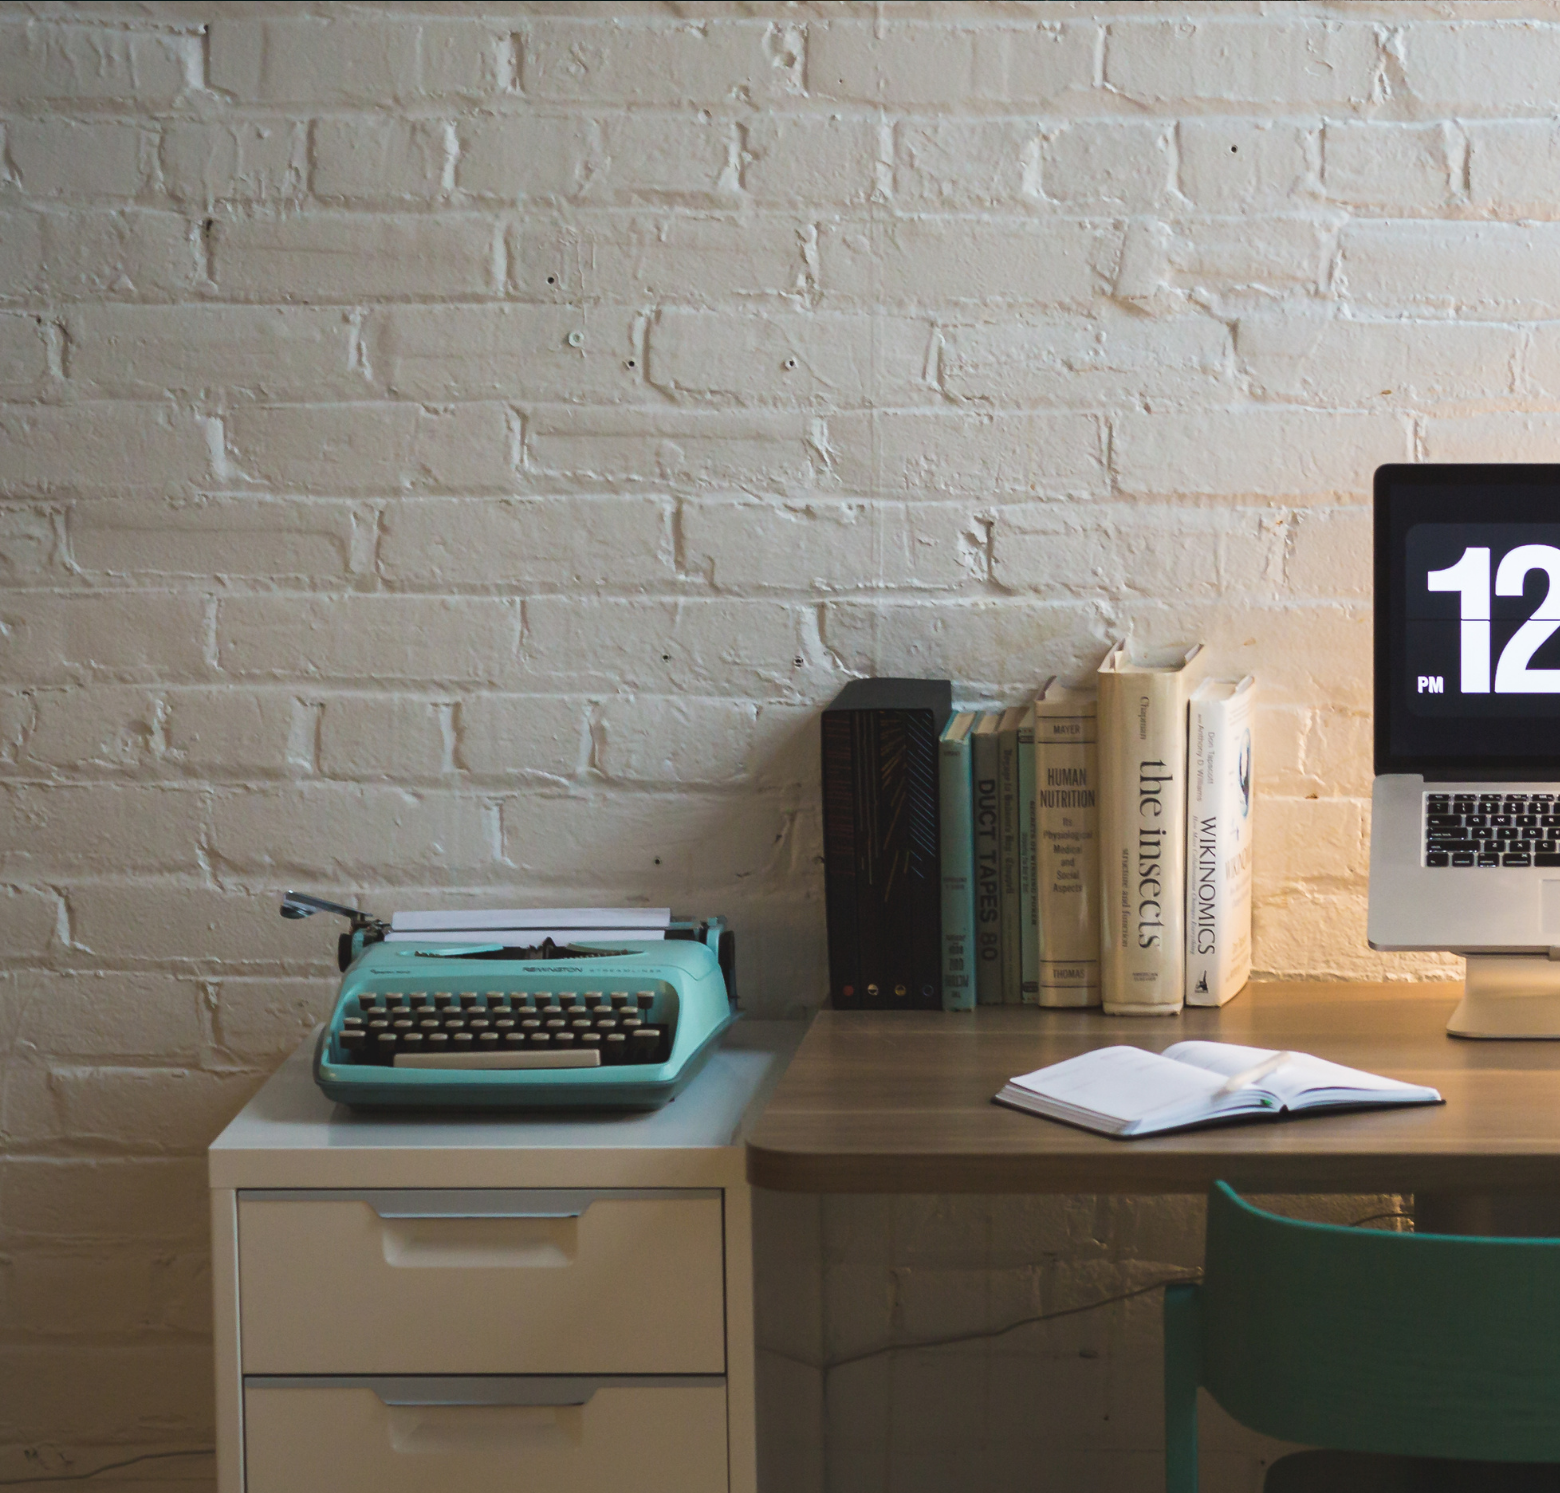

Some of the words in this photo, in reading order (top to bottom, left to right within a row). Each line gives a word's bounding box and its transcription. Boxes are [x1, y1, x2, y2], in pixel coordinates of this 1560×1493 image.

[1417, 675, 1444, 693] PM
[1053, 724, 1081, 735] MAYER
[1047, 768, 1087, 787] HUMAN
[1138, 760, 1173, 817] the
[1040, 789, 1096, 808] NUTRITION
[978, 779, 997, 841] DUCT
[1053, 844, 1083, 855] Medical
[1060, 857, 1075, 867] and
[1121, 848, 1129, 889] structure
[1057, 869, 1080, 880] Social
[978, 849, 998, 923] TAPES
[1052, 883, 1083, 895] Aspects
[1138, 828, 1167, 950] insects
[1197, 816, 1217, 955] WIKINOMICS
[1122, 890, 1131, 908] and
[1121, 910, 1131, 948] function
[978, 932, 998, 962] 80
[522, 966, 583, 974] REMINGTON
[1053, 968, 1086, 979] THOMAS
